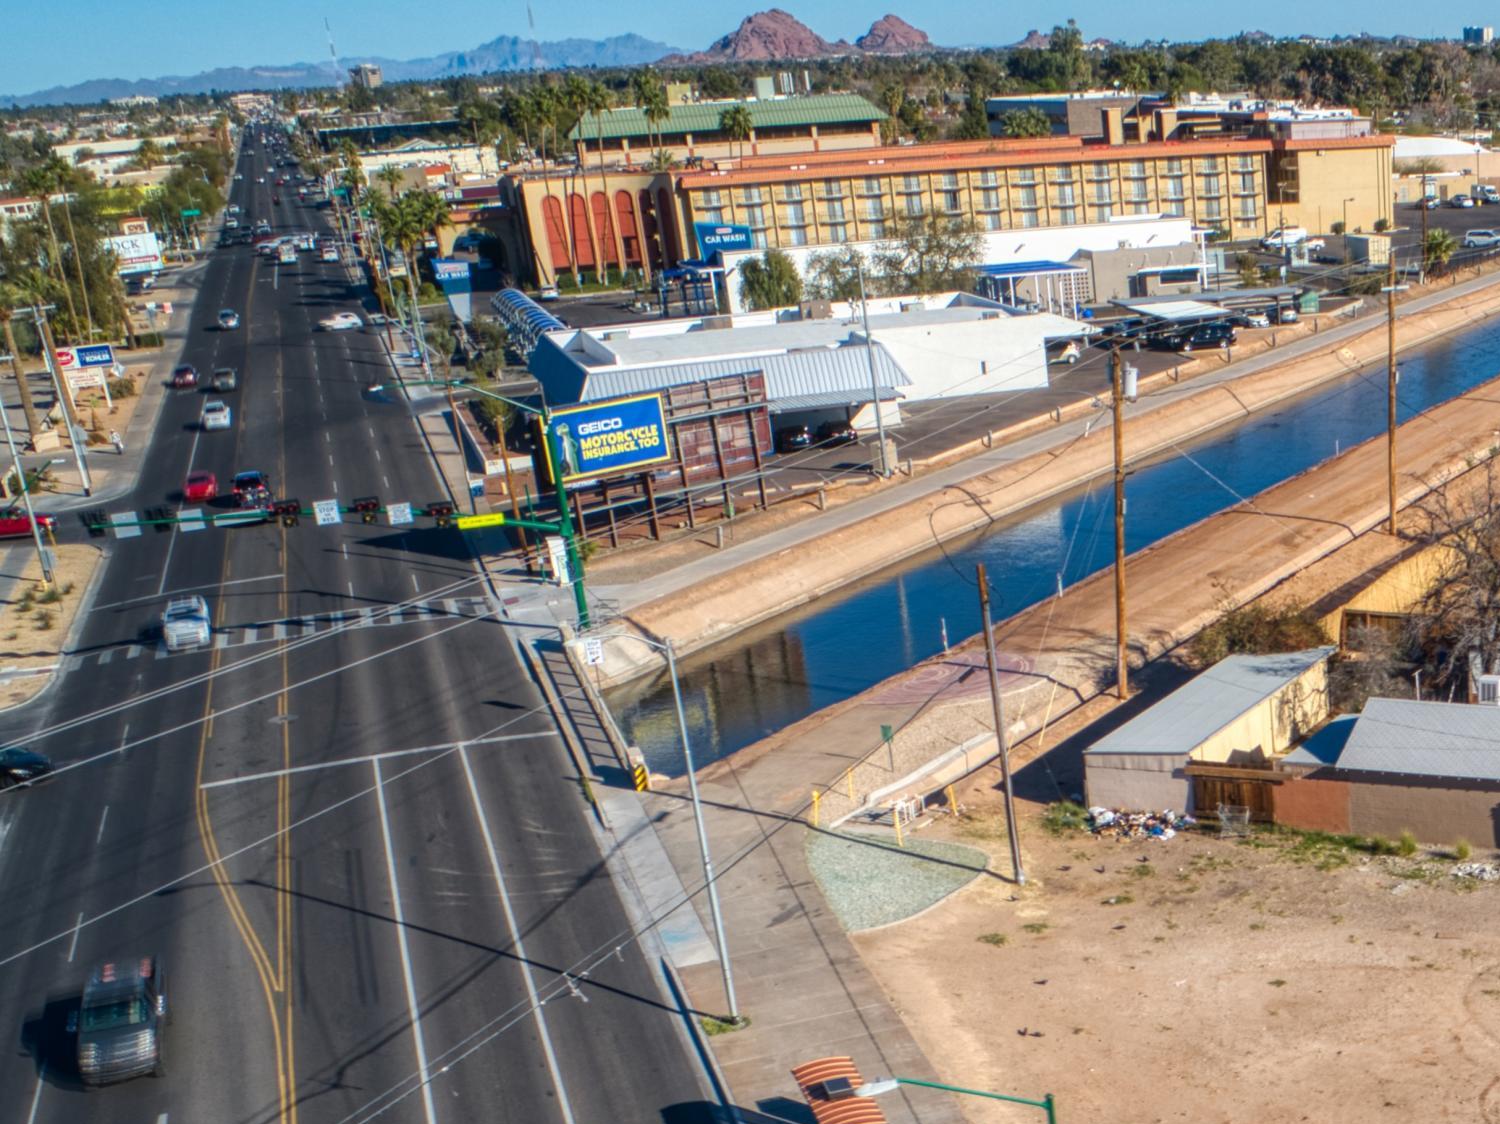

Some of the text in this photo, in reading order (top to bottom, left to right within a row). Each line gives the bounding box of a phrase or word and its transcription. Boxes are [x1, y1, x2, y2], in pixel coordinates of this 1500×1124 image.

[705, 234, 746, 244] CAR WASH
[578, 417, 622, 435] GEICO
[581, 424, 658, 450] MOTORCYCLE
[582, 436, 660, 460] INSURANCE, TOO
